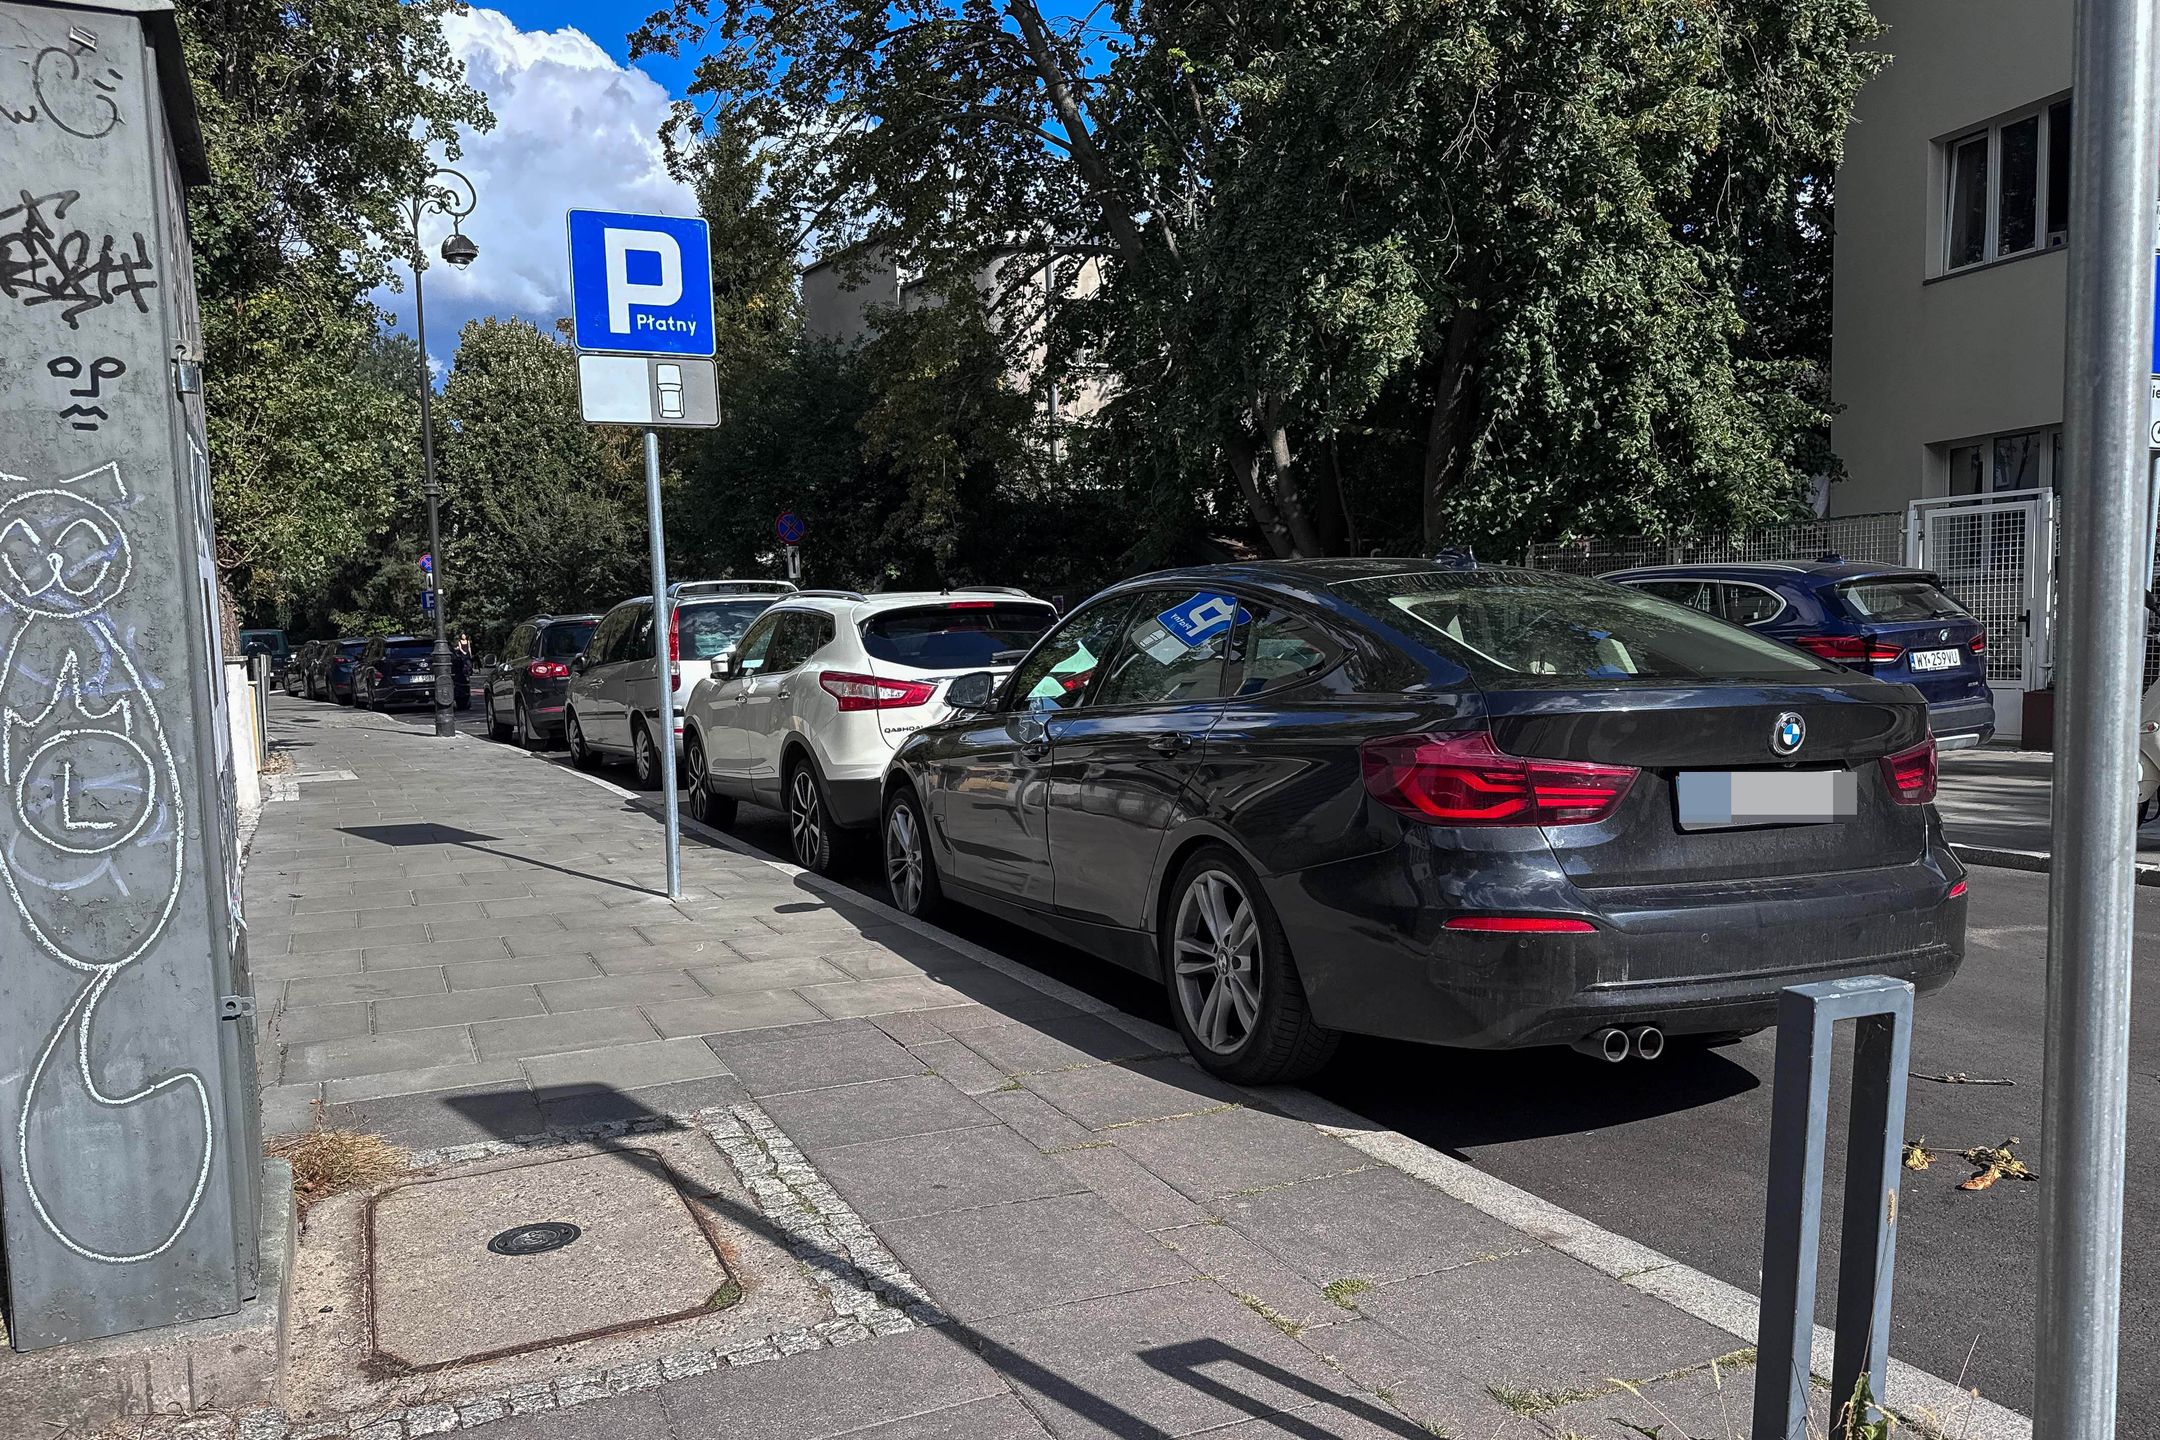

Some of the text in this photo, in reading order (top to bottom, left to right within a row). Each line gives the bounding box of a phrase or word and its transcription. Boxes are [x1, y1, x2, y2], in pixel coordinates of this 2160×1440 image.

[604, 227, 683, 334] P
[637, 314, 697, 336] Płatny
[1916, 650, 1958, 667] WY 259VU
